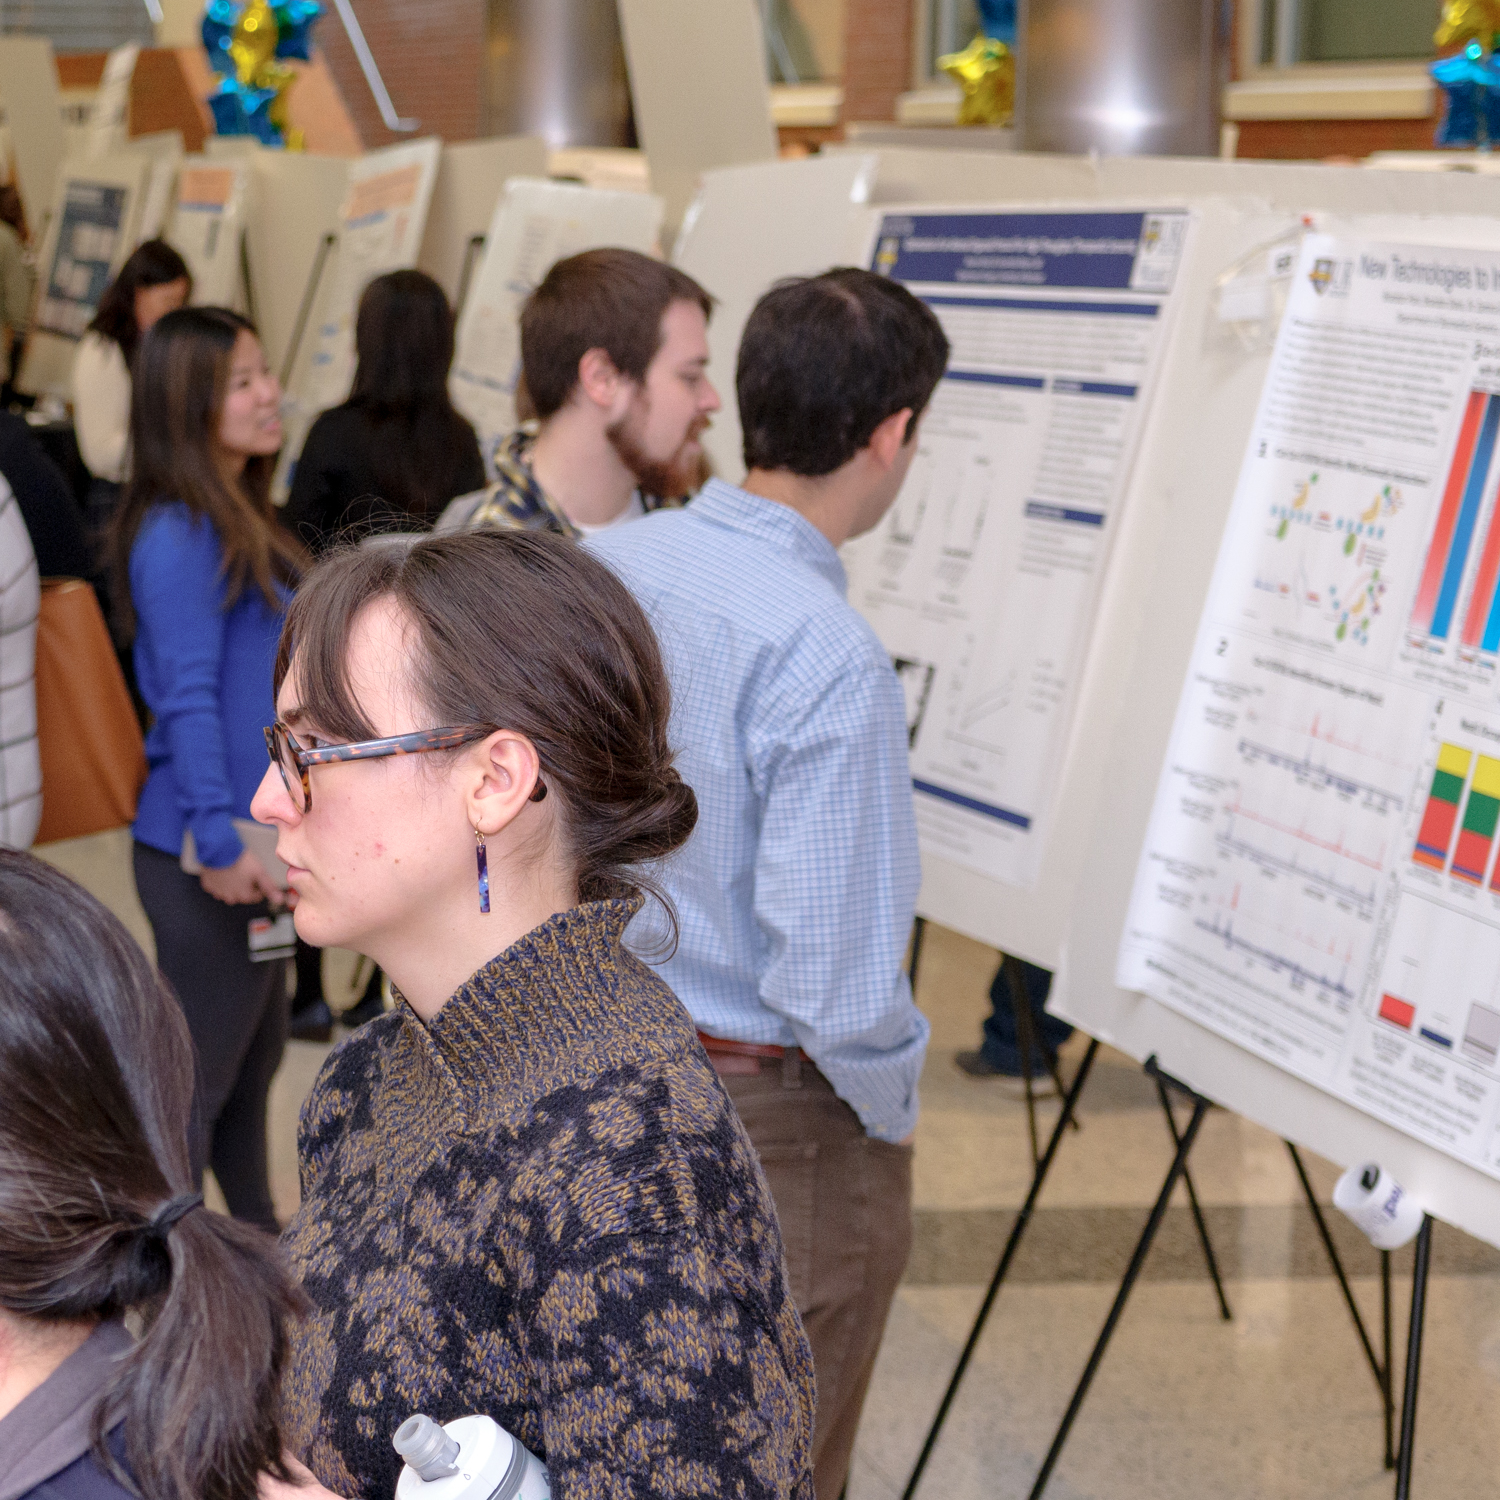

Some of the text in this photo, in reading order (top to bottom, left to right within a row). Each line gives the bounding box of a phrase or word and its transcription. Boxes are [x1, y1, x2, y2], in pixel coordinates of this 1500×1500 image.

[1361, 253, 1387, 281] New
[1391, 254, 1472, 293] Technologies
[1475, 263, 1488, 291] to
